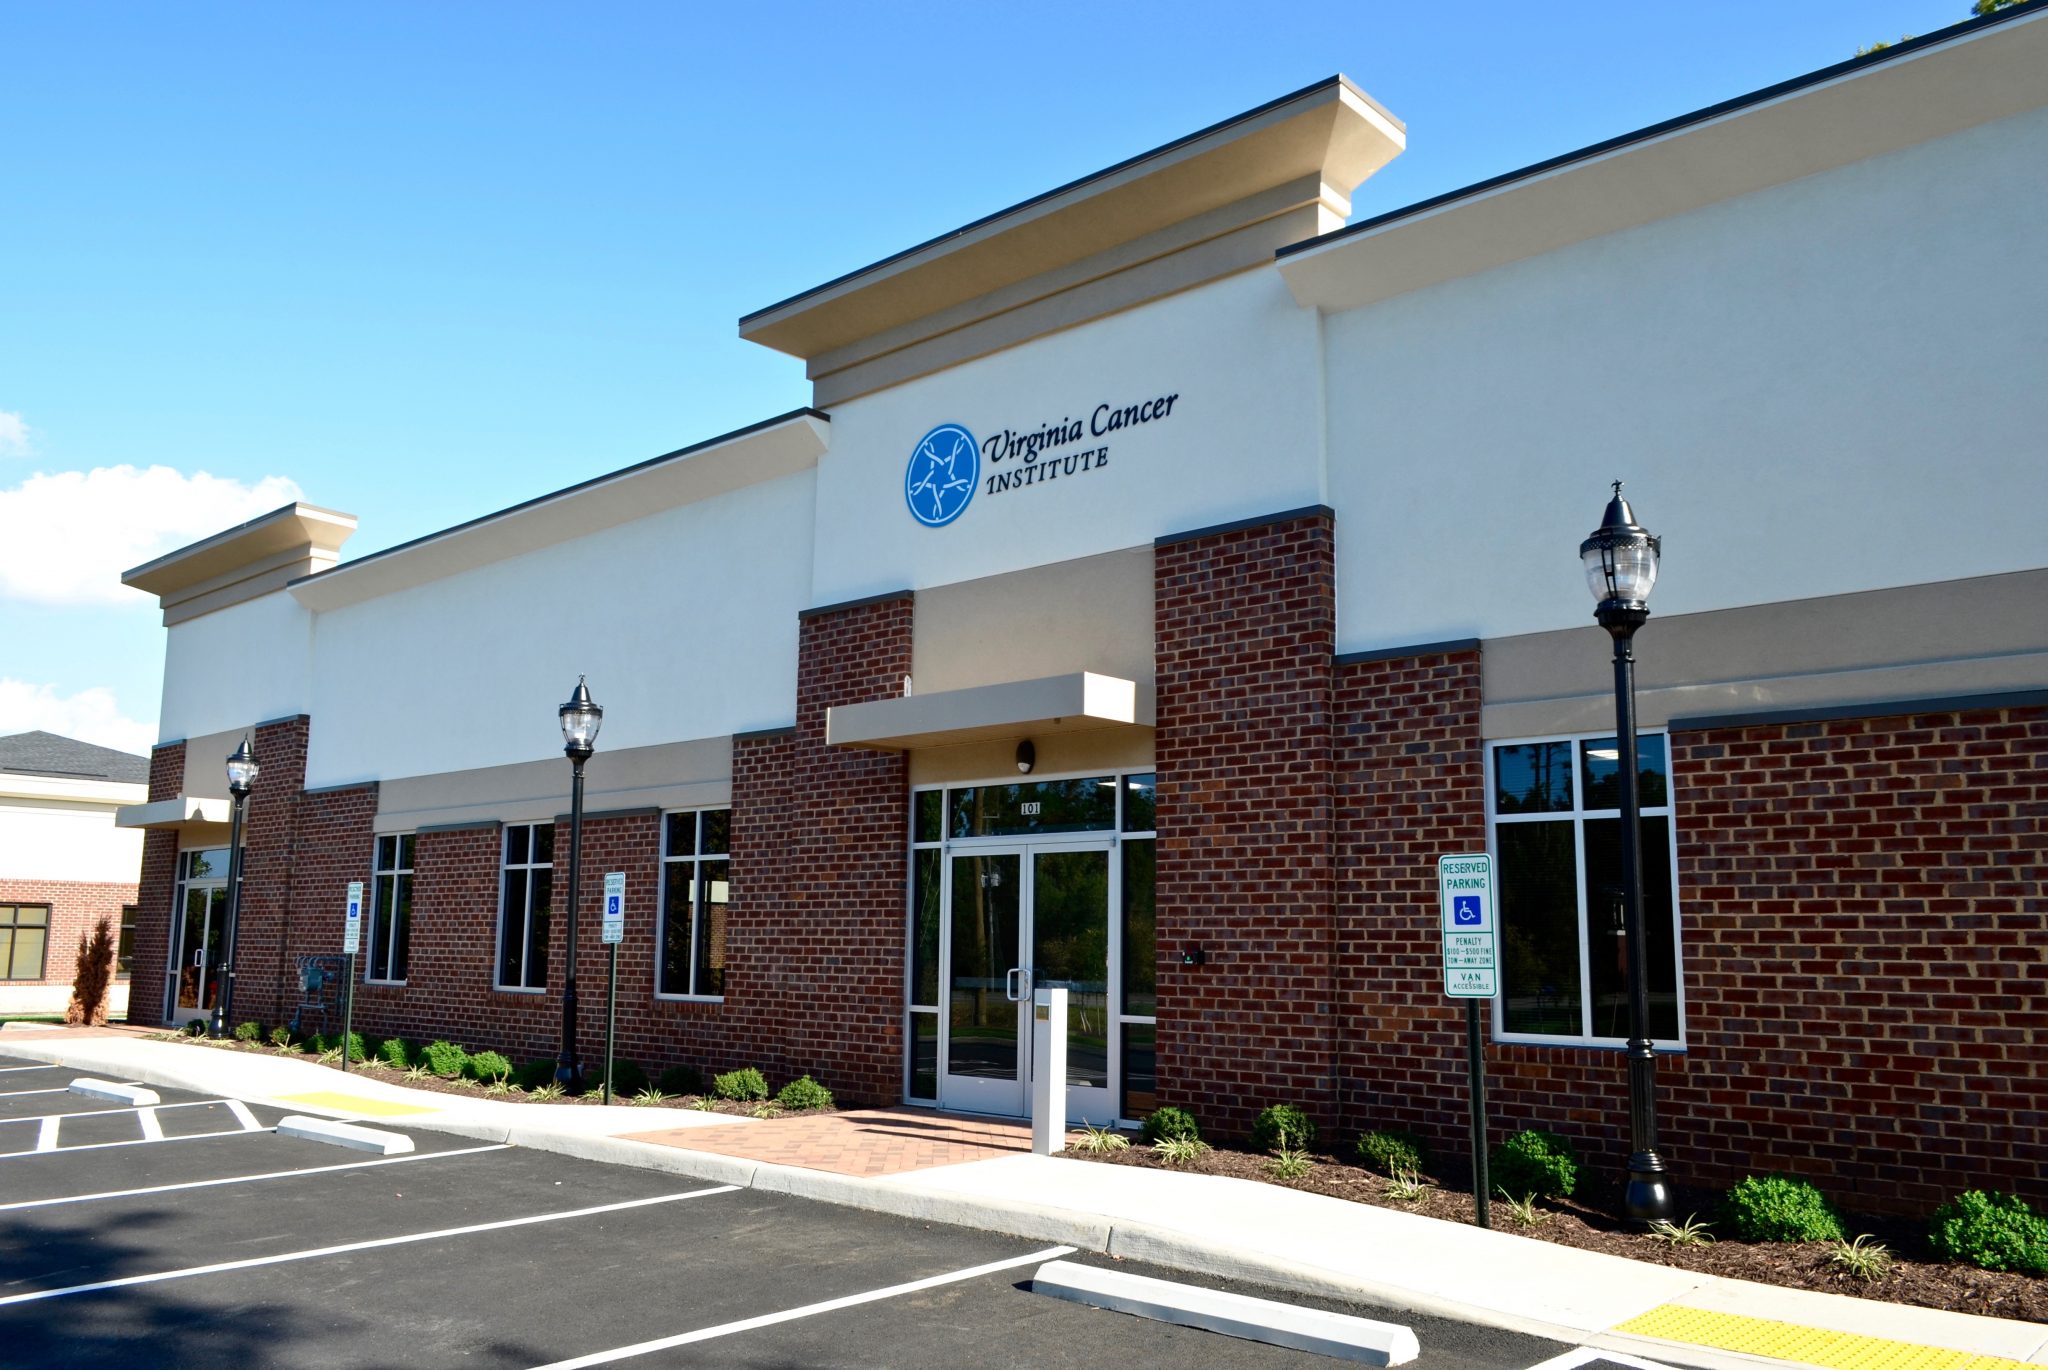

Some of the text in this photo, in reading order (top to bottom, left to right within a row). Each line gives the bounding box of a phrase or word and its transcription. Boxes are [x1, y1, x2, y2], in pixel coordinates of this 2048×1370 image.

[982, 393, 1179, 463] Virginia Cancer
[986, 447, 1109, 495] INSTITUTE
[1022, 803, 1039, 814] 101
[1443, 862, 1488, 874] RESERVED
[1446, 878, 1486, 890] PARKING
[1455, 937, 1482, 946] PENALTY
[1460, 973, 1481, 981] VAN
